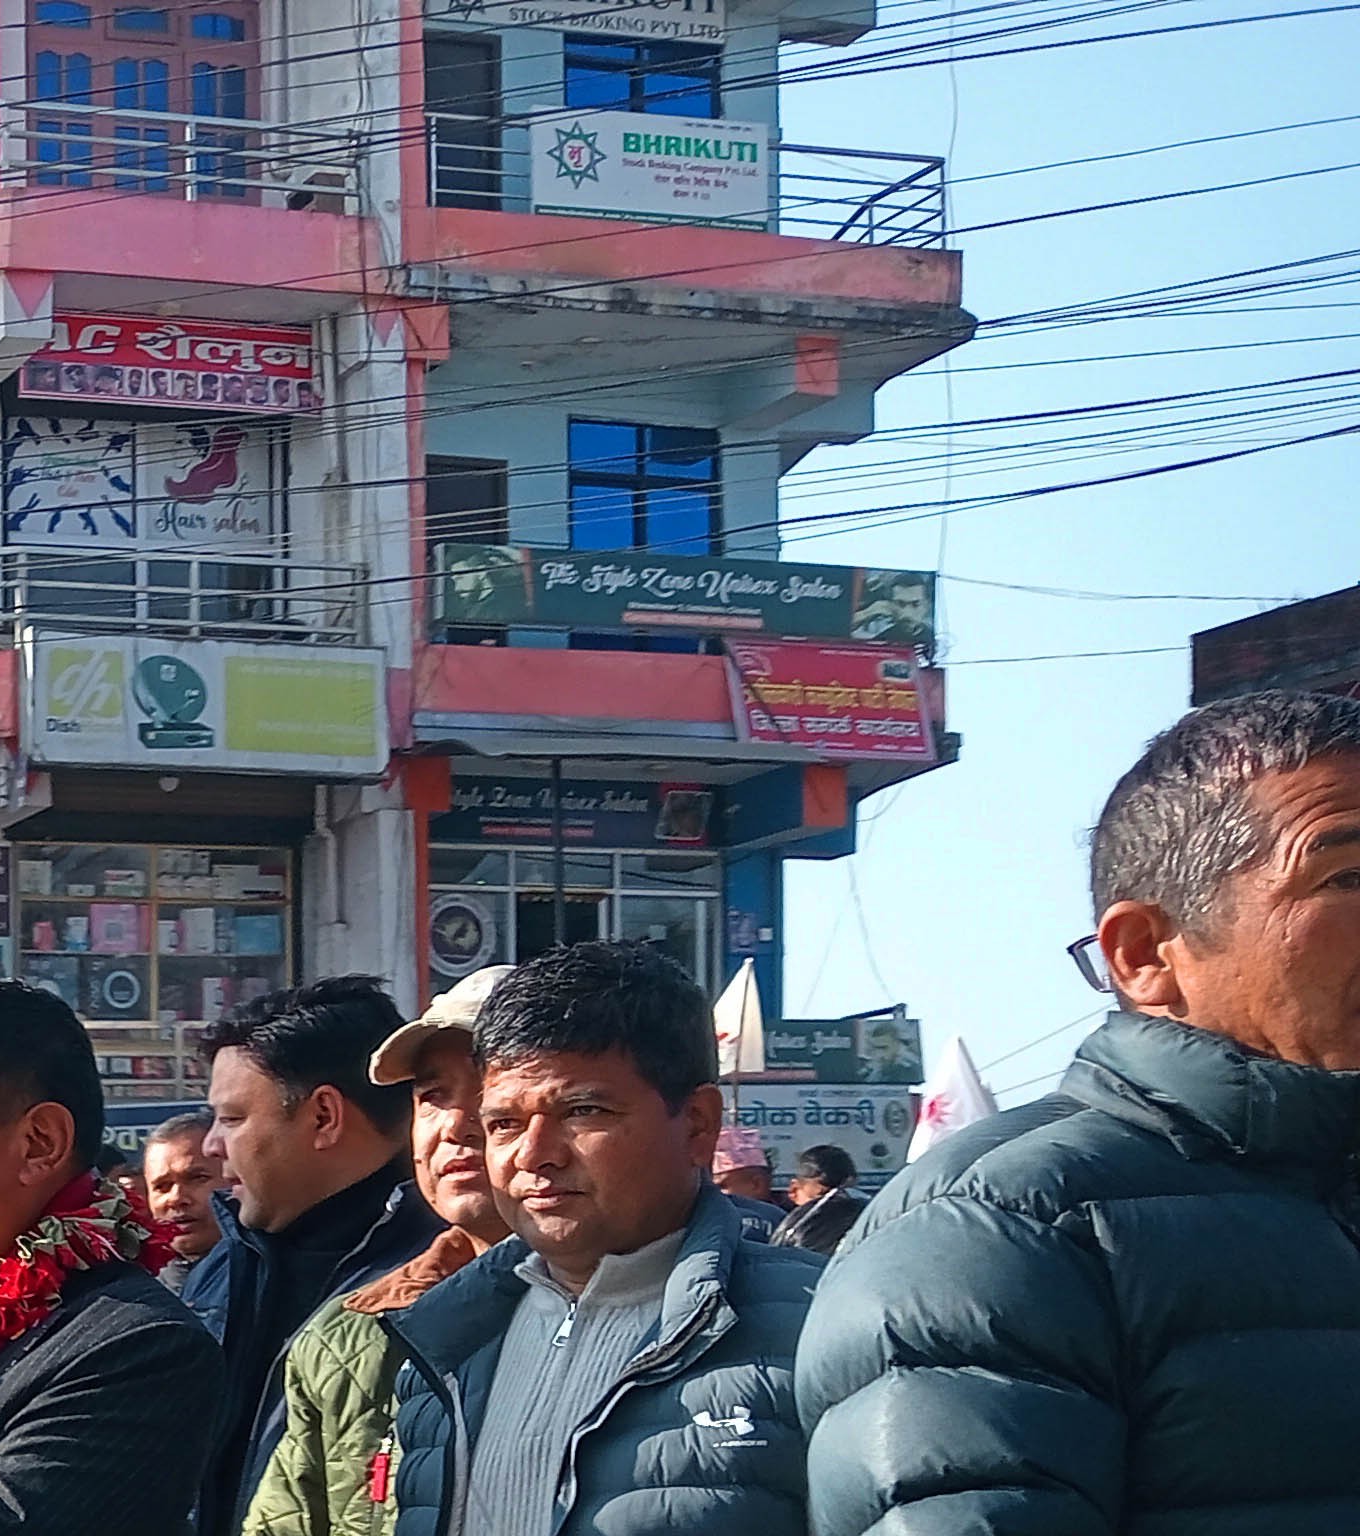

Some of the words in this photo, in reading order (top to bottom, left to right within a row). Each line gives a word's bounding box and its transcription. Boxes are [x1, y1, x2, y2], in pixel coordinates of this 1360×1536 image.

[509, 7, 564, 24] STOCK
[570, 13, 646, 33] BROKING
[623, 132, 758, 163] BHRIKUTI
[156, 502, 207, 540] Hair
[540, 562, 580, 590] The
[641, 567, 695, 598] Zone
[697, 570, 779, 604] Unisex
[780, 576, 843, 604] Salon
[453, 787, 484, 811] tyle
